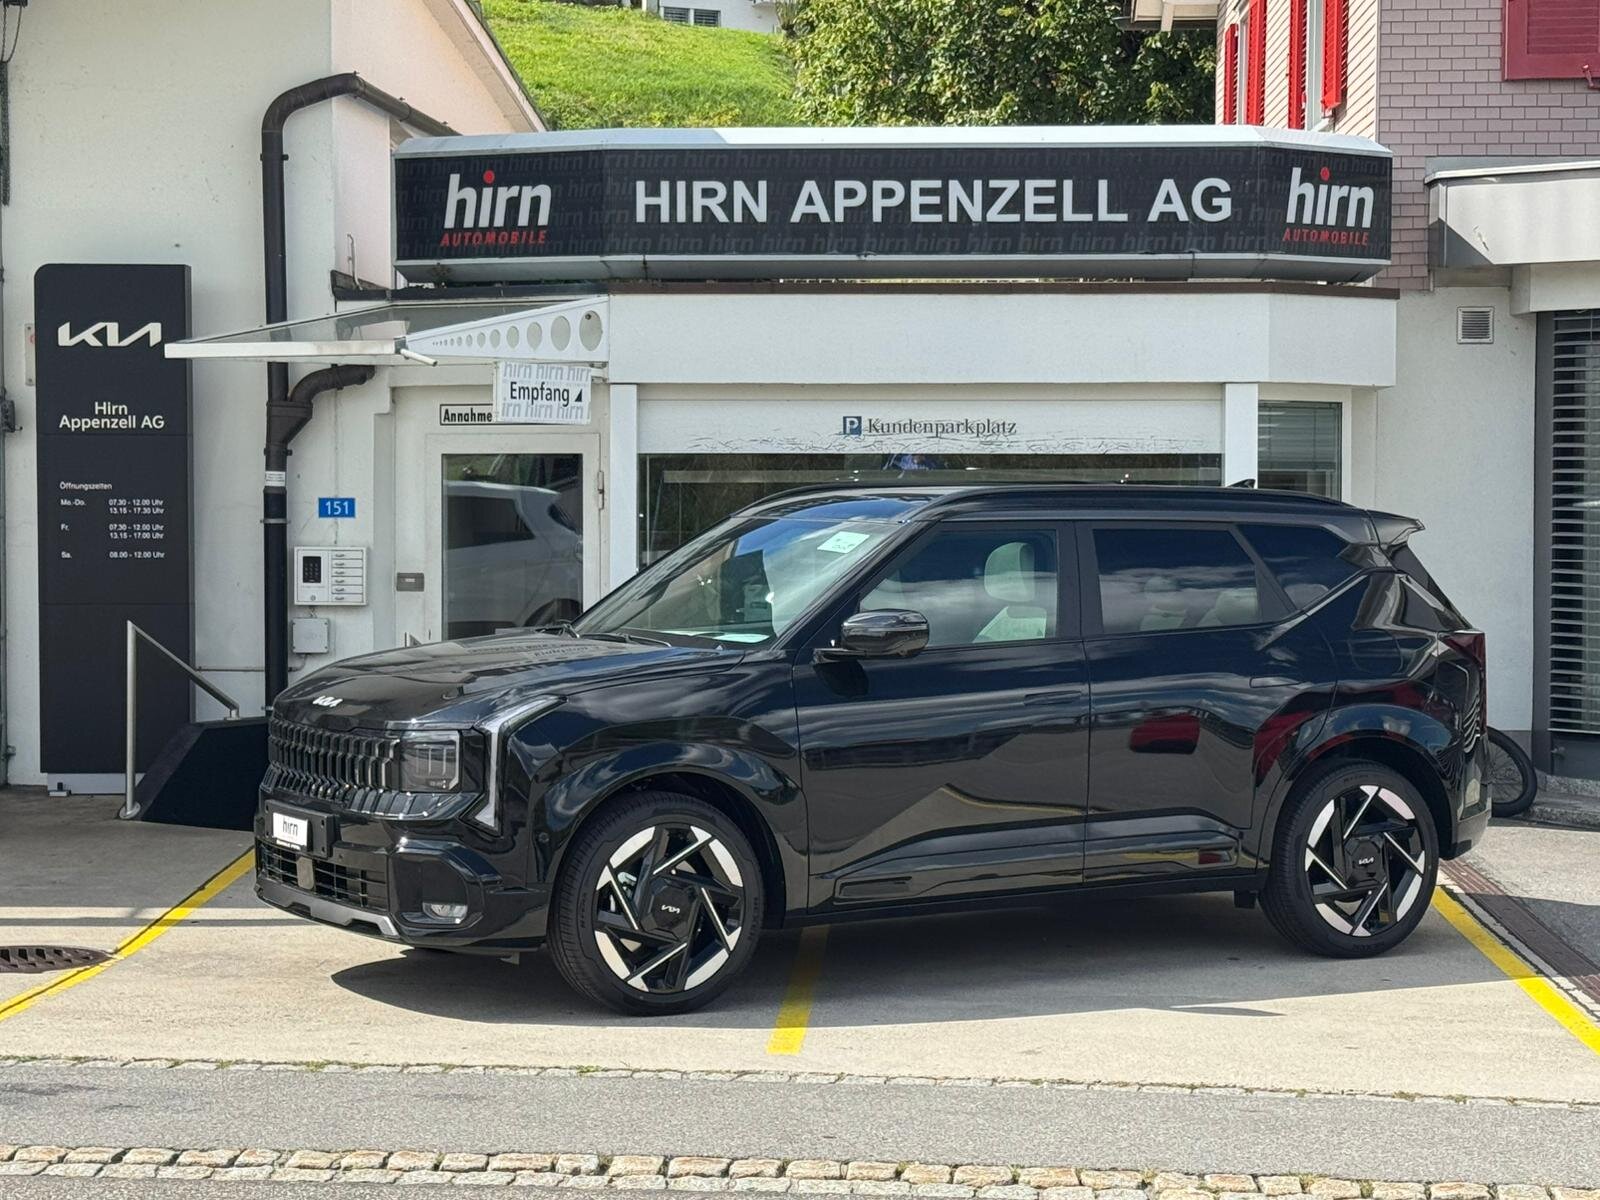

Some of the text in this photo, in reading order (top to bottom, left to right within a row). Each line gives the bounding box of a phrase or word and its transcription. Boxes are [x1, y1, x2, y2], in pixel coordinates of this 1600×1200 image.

[443, 170, 552, 229] hirn
[635, 176, 1233, 224] HIRN APPENZELL AG
[1285, 166, 1375, 229] hirn
[440, 228, 549, 248] AUTOMOBILE
[1282, 227, 1369, 247] AUTOMOBILE
[58, 321, 162, 347] KIA
[504, 362, 533, 379] hirn
[536, 364, 565, 380] hirn
[510, 381, 570, 407] Empfang
[94, 401, 128, 415] Hirn
[443, 407, 493, 423] Annahme
[525, 402, 554, 419] hirn
[557, 404, 585, 420] hirn
[59, 415, 165, 432] Appenzell AG
[867, 418, 1017, 438] Kundenparkplatz
[59, 481, 113, 491] Öffnungszeiten
[325, 501, 350, 515] 151
[283, 816, 299, 837] hirn
